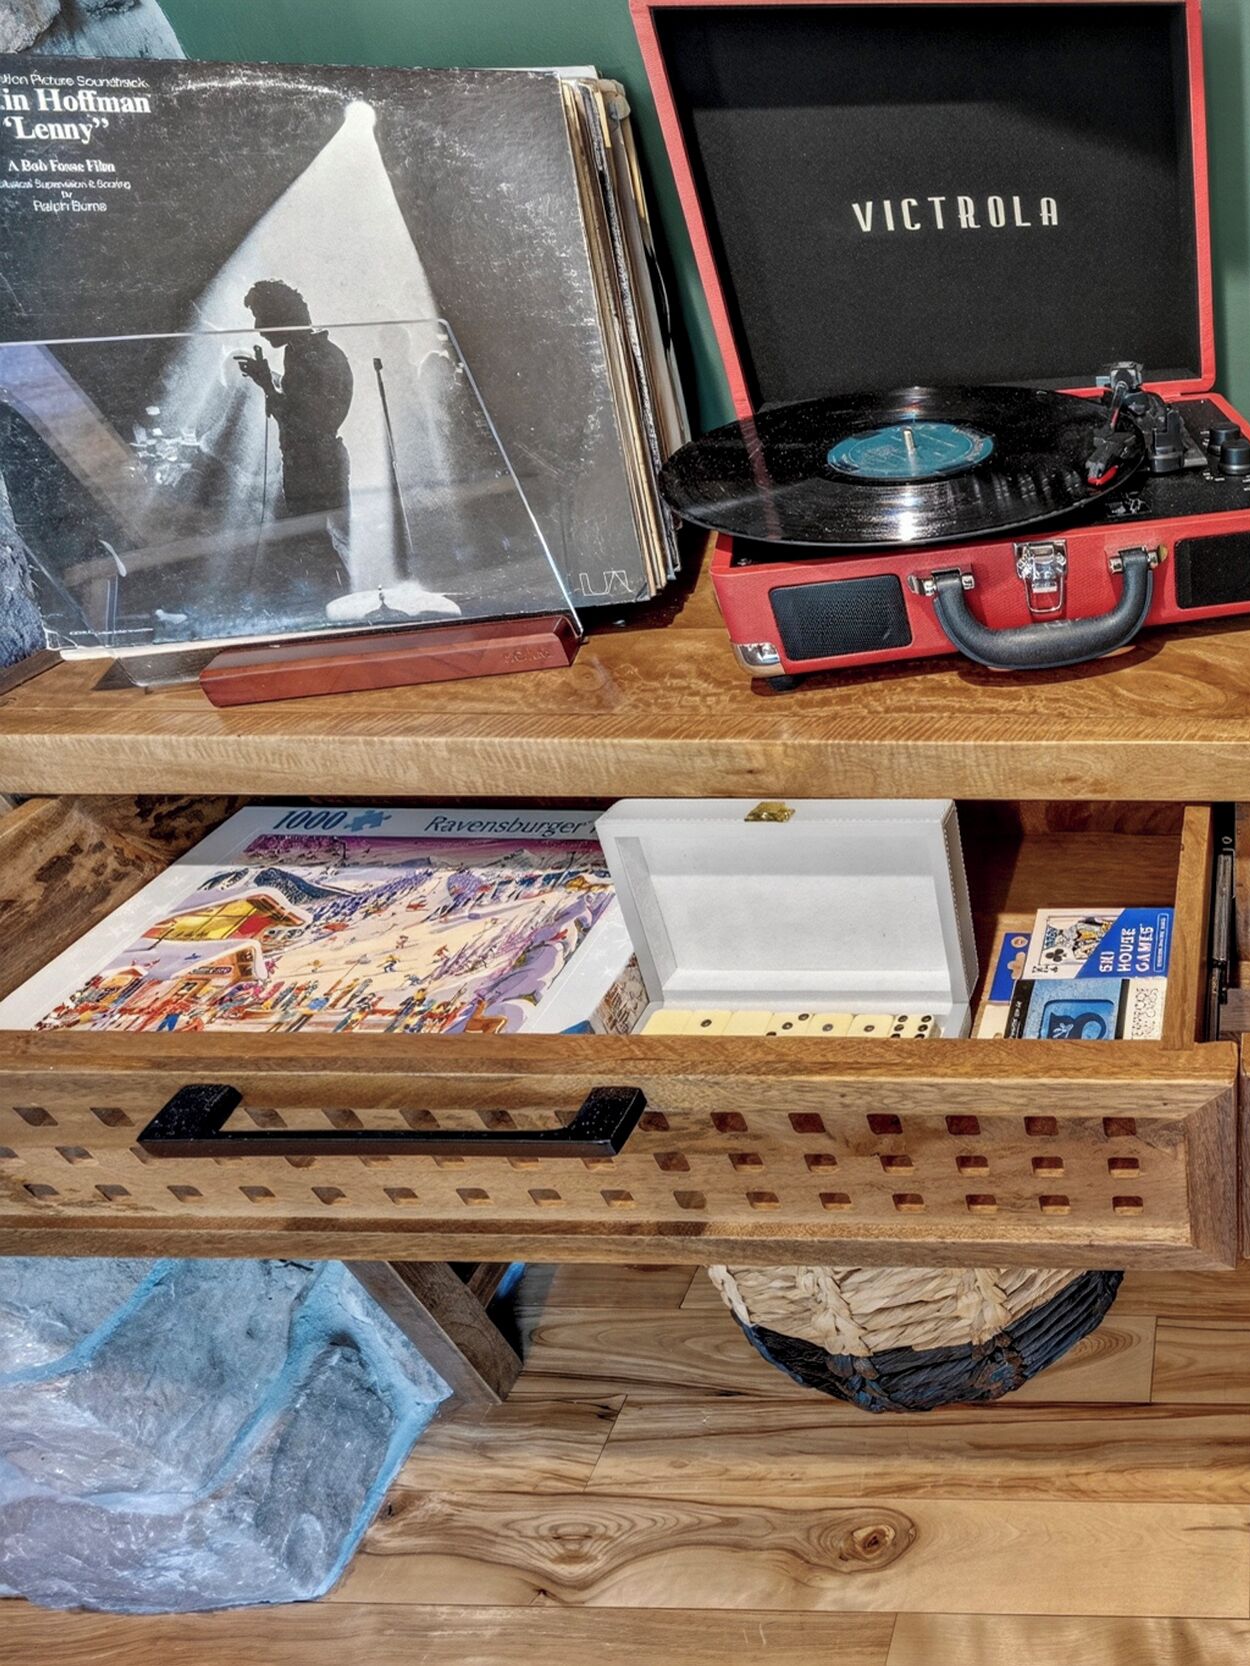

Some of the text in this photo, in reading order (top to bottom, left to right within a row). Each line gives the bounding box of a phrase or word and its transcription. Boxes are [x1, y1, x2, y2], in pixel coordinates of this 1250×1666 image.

[30, 74, 75, 86] Picture
[76, 75, 147, 88] Soundtrack
[0, 88, 152, 113] in Hoffman
[8, 159, 116, 173] A Bob Fosse Film
[33, 199, 107, 214] Ralph Burns
[851, 195, 1059, 233] VICTROLA
[272, 809, 584, 838] 1000 Ravensburger
[1098, 950, 1116, 973] SKI
[1116, 927, 1137, 973] HOUSE
[1135, 925, 1154, 973] GAMES
